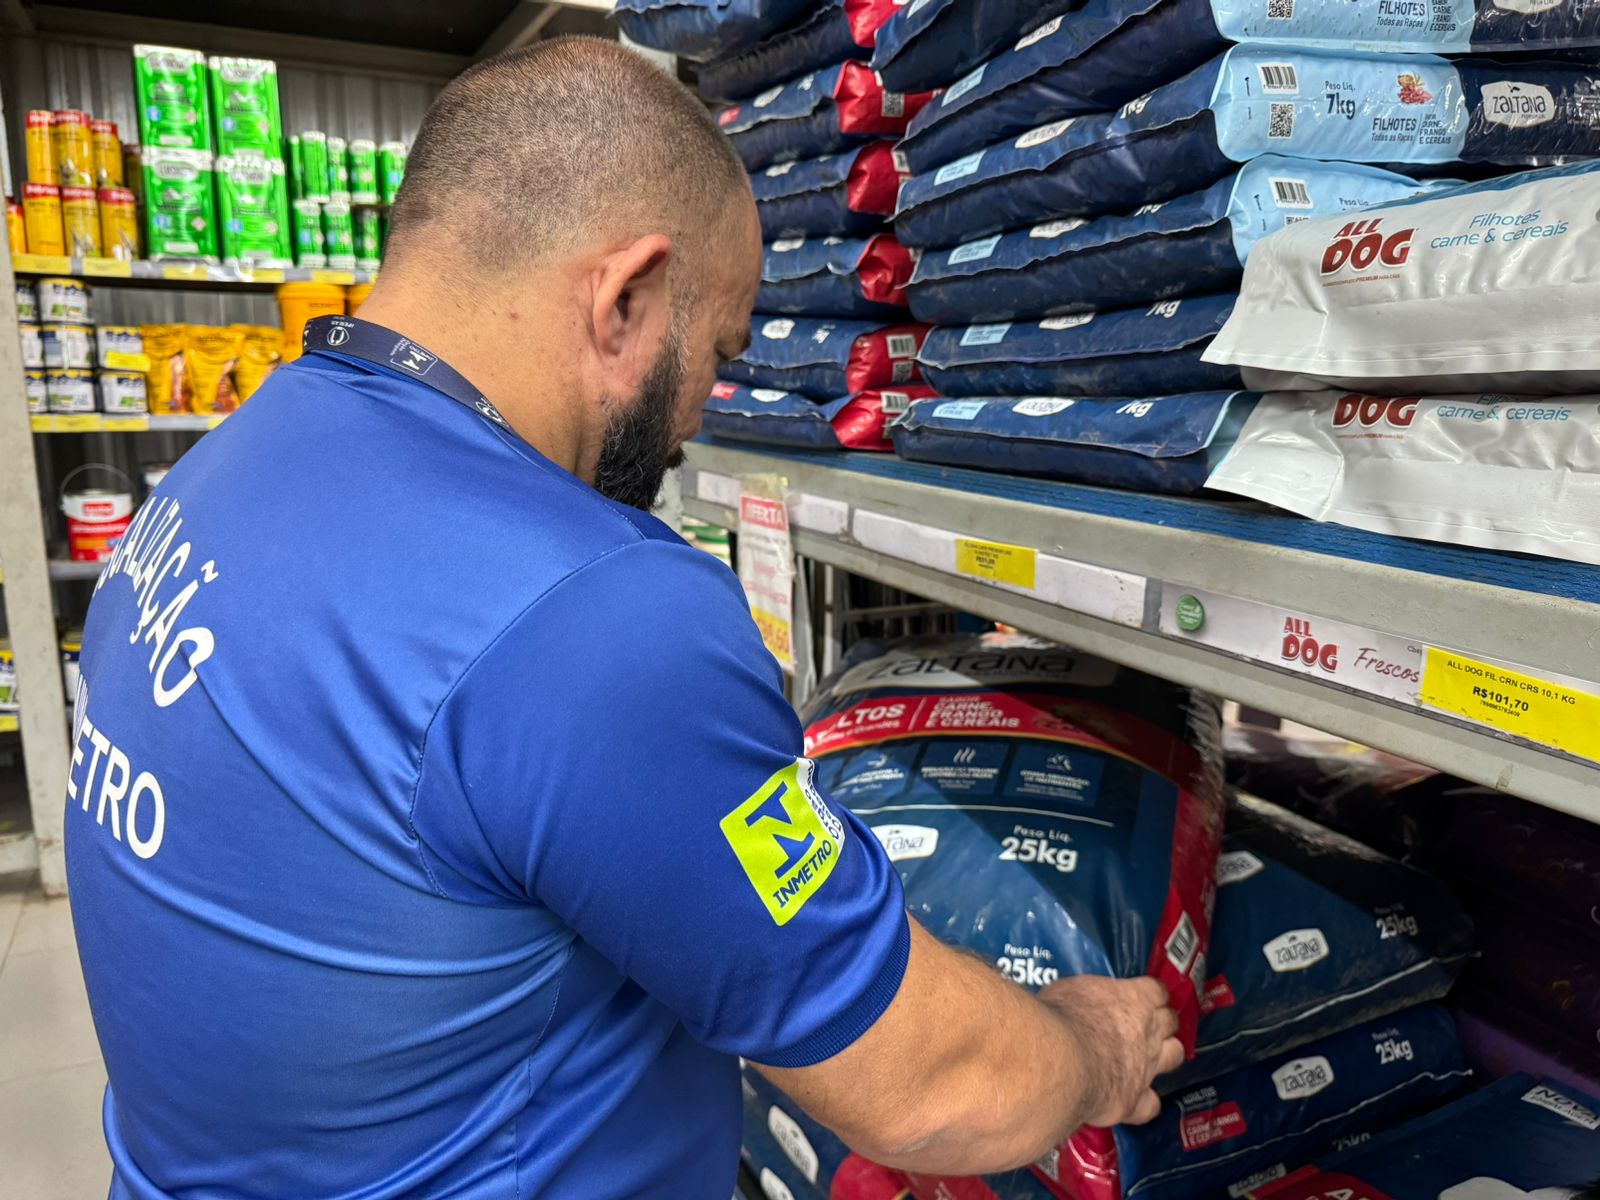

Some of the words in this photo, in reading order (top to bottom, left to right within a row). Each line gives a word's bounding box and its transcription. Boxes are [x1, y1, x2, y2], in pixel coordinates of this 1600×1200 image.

[1379, 0, 1425, 16] FILHOTES
[1325, 81, 1341, 90] Peso
[1326, 92, 1355, 120] 7kg
[1372, 117, 1417, 131] FILHOTES
[1419, 136, 1425, 144] E
[1332, 217, 1384, 239] ALL
[1468, 209, 1541, 229] Filhotes
[1431, 233, 1481, 249] carne
[1484, 228, 1497, 244] &
[1502, 219, 1569, 243] cereais
[1320, 228, 1416, 277] DOG
[1331, 395, 1421, 428] DOG
[1436, 404, 1485, 420] carne
[1505, 406, 1573, 422] cereais
[1283, 616, 1312, 637] ALL
[1281, 633, 1339, 673] DOG
[1353, 646, 1419, 684] Frescos
[1447, 660, 1462, 671] ALL
[1464, 665, 1483, 677] DOG
[1485, 671, 1497, 681] FIL
[1499, 676, 1517, 688] CRN
[1519, 682, 1539, 694] CRS
[1561, 694, 1576, 706] KG
[1472, 685, 1529, 712] R$101,70
[925, 719, 937, 728] E
[939, 717, 1021, 728] CEREAIS
[929, 709, 1004, 720] FRANGO
[1014, 825, 1045, 838] Peso
[998, 836, 1079, 872] 25kg
[773, 839, 832, 908] INMETRO
[1376, 914, 1419, 940] 25kg
[1004, 943, 1031, 957] Peso
[1375, 1038, 1414, 1065] 25kg
